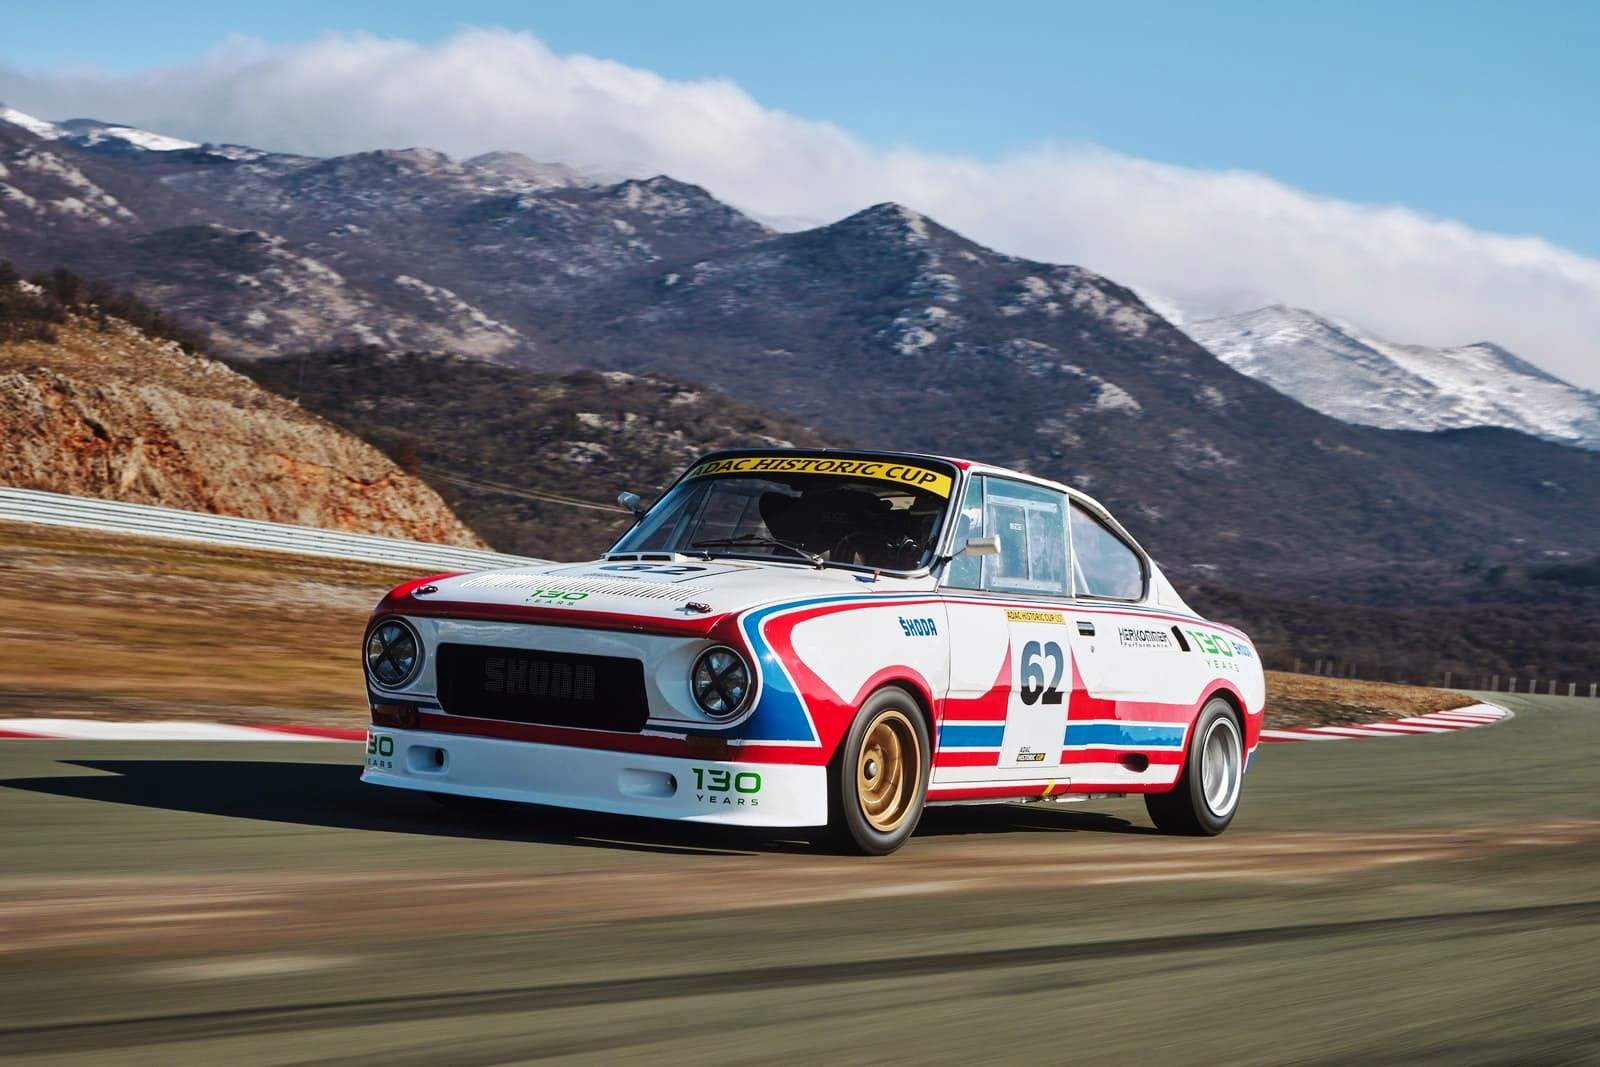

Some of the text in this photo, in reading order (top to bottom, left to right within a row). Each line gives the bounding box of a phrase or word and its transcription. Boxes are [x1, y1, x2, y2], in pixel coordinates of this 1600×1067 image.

[689, 458, 937, 485] ADAC HISTORIC CUP
[531, 589, 589, 600] 130
[1185, 630, 1232, 657] 130
[1020, 640, 1064, 706] 62
[692, 768, 762, 794] 130
[696, 794, 759, 806] YEARS
